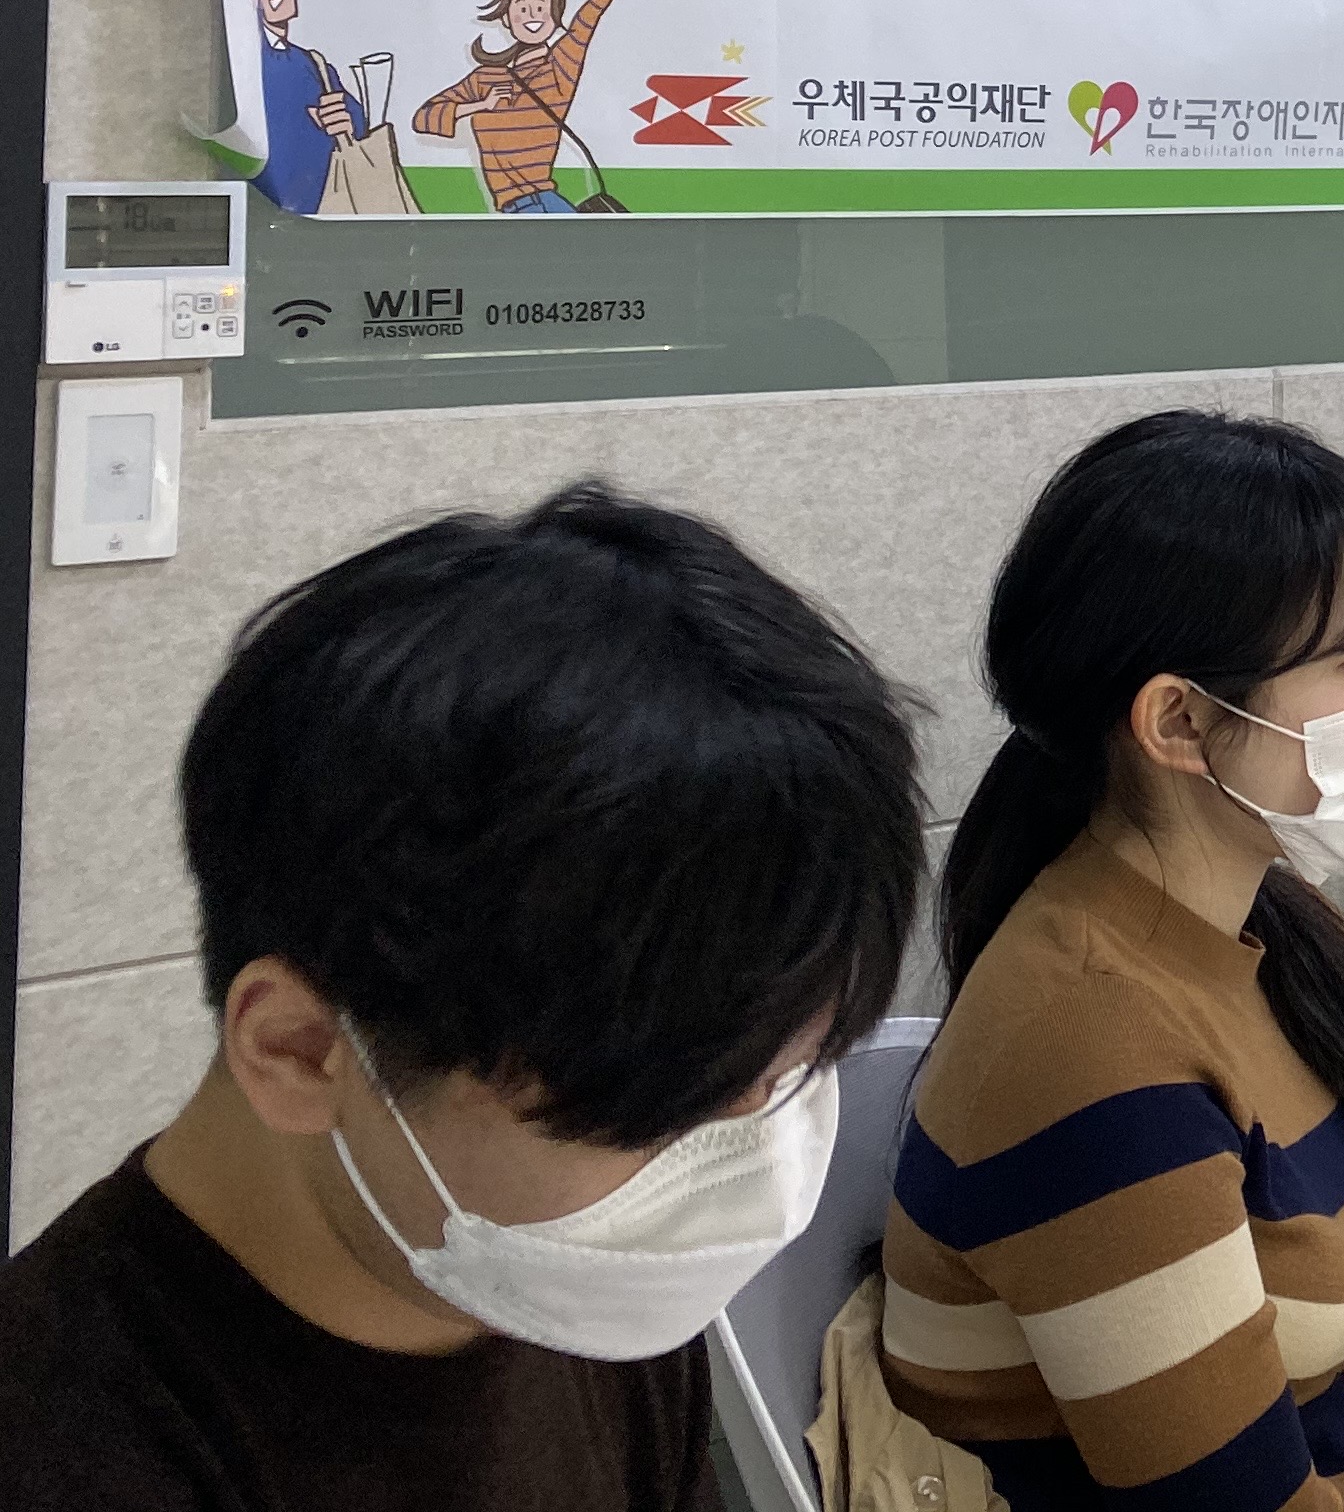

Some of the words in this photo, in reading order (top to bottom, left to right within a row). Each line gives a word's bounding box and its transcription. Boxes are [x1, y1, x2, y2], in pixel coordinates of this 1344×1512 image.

[792, 78, 1052, 123] 우체국공익재단
[798, 129, 861, 147] KOREA
[867, 129, 918, 148] POST
[921, 130, 1046, 149] FOUNDATION
[1146, 144, 1272, 157] Rehabilitation
[364, 288, 463, 318] WIFI
[486, 299, 645, 325] 01084328733
[363, 323, 463, 338] PASSWORD
